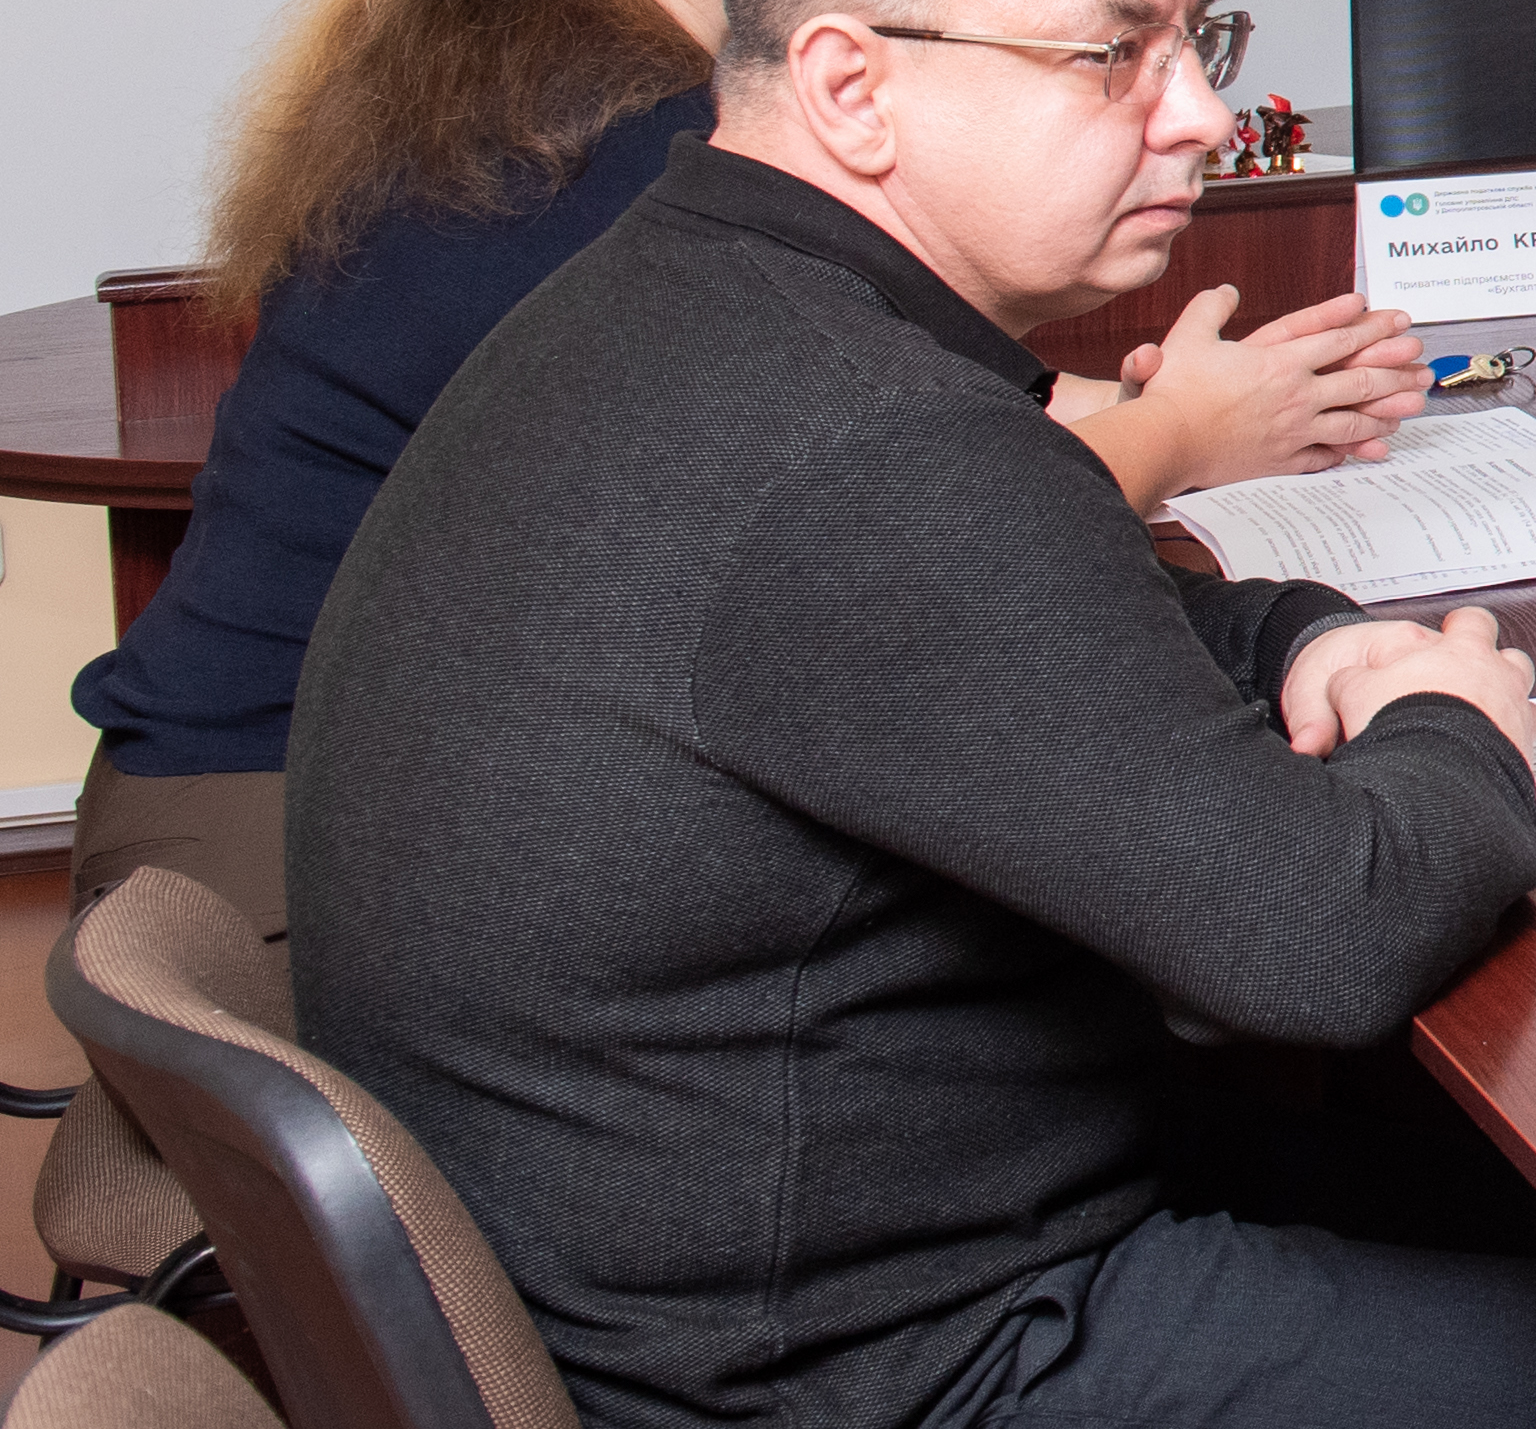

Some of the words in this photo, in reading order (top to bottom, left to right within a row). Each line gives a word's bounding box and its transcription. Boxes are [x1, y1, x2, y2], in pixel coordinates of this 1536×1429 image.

[1388, 236, 1498, 257] Михайло
[1394, 278, 1450, 290] Приватне
[1453, 272, 1534, 285] підприємство
